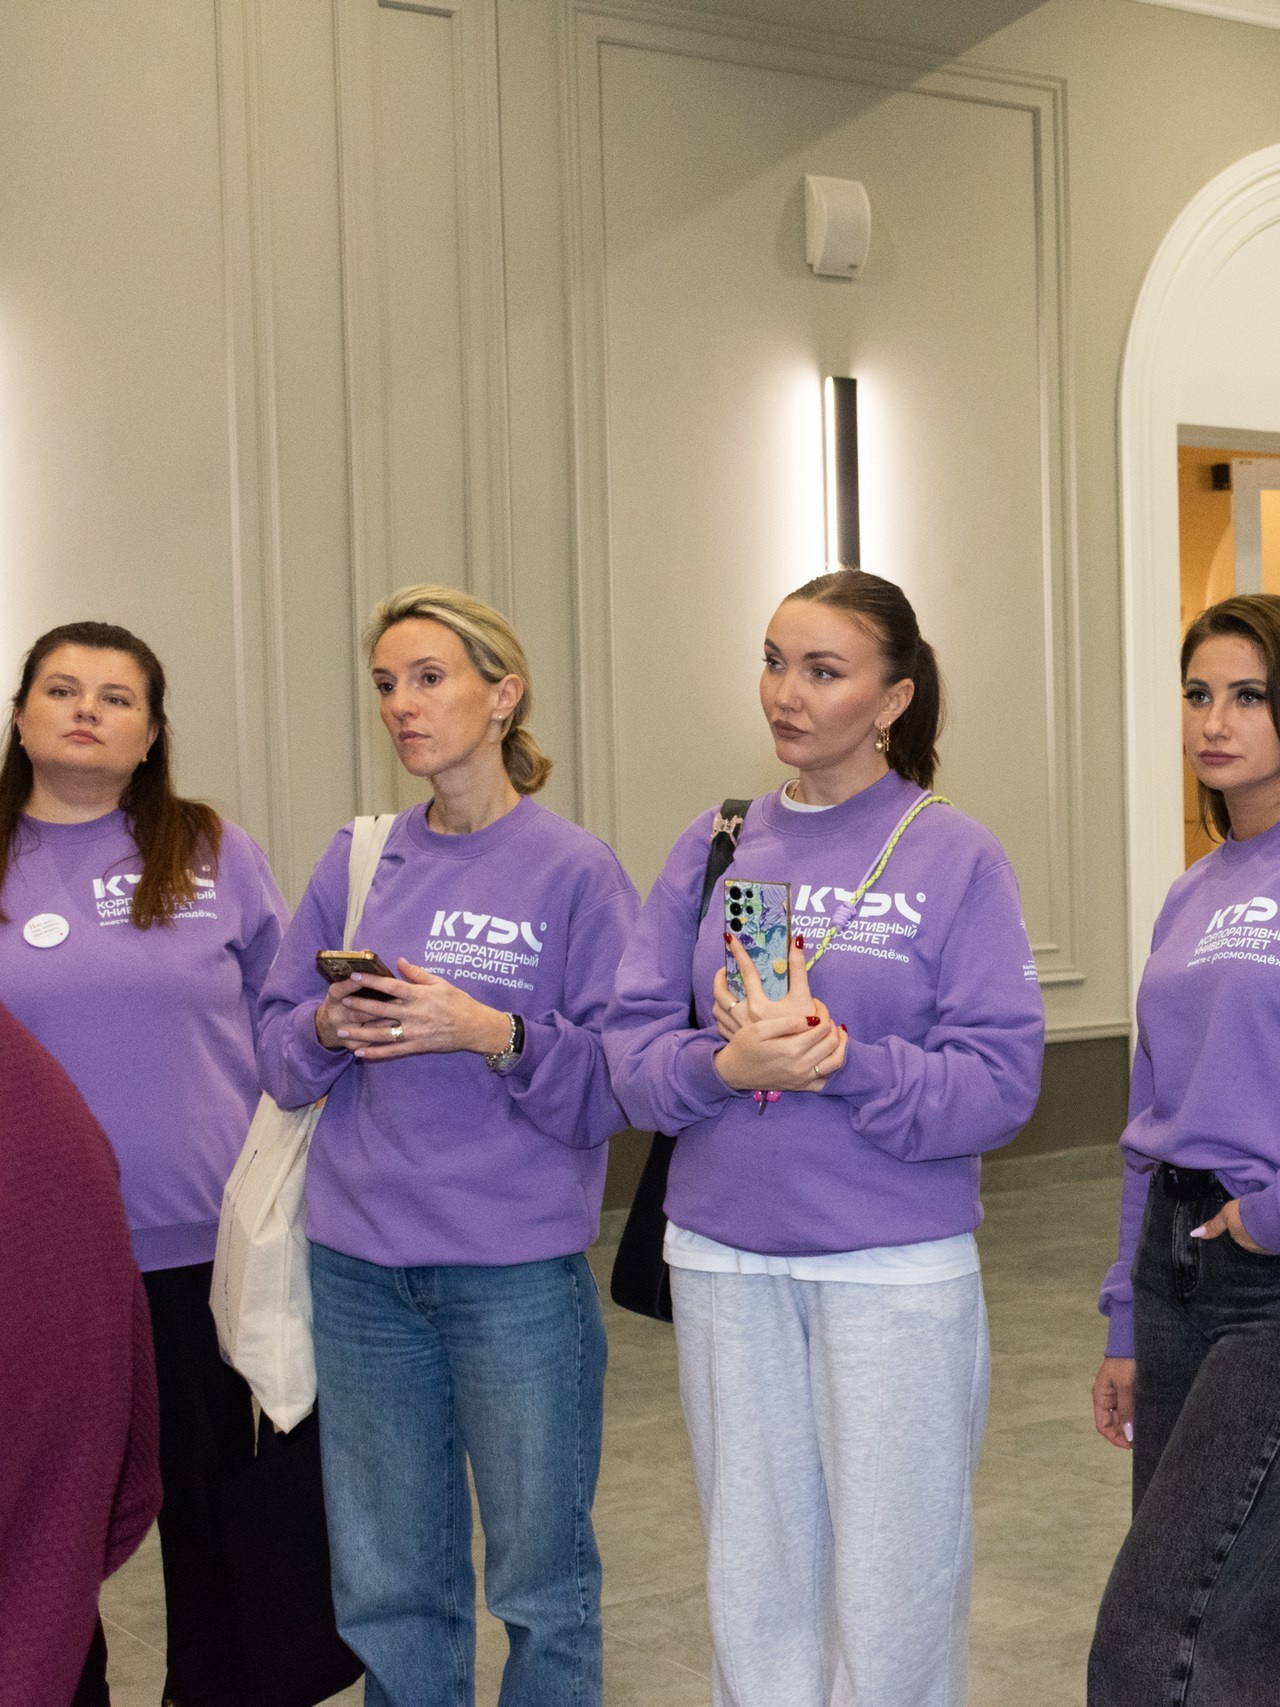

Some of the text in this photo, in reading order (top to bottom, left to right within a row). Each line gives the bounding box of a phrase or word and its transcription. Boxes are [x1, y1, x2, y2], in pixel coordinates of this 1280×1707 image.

[791, 915, 917, 939] КОРПАТИВНЫЙ
[791, 926, 889, 945] УНИВРСИТЕТ
[426, 940, 539, 967] КОРПОРАТИВНЫЙ
[1194, 937, 1271, 956] УНИВЕРСИТЕТ
[424, 951, 518, 975] УНИВЕРСИТЕТ
[454, 968, 534, 991] росмолодёжь
